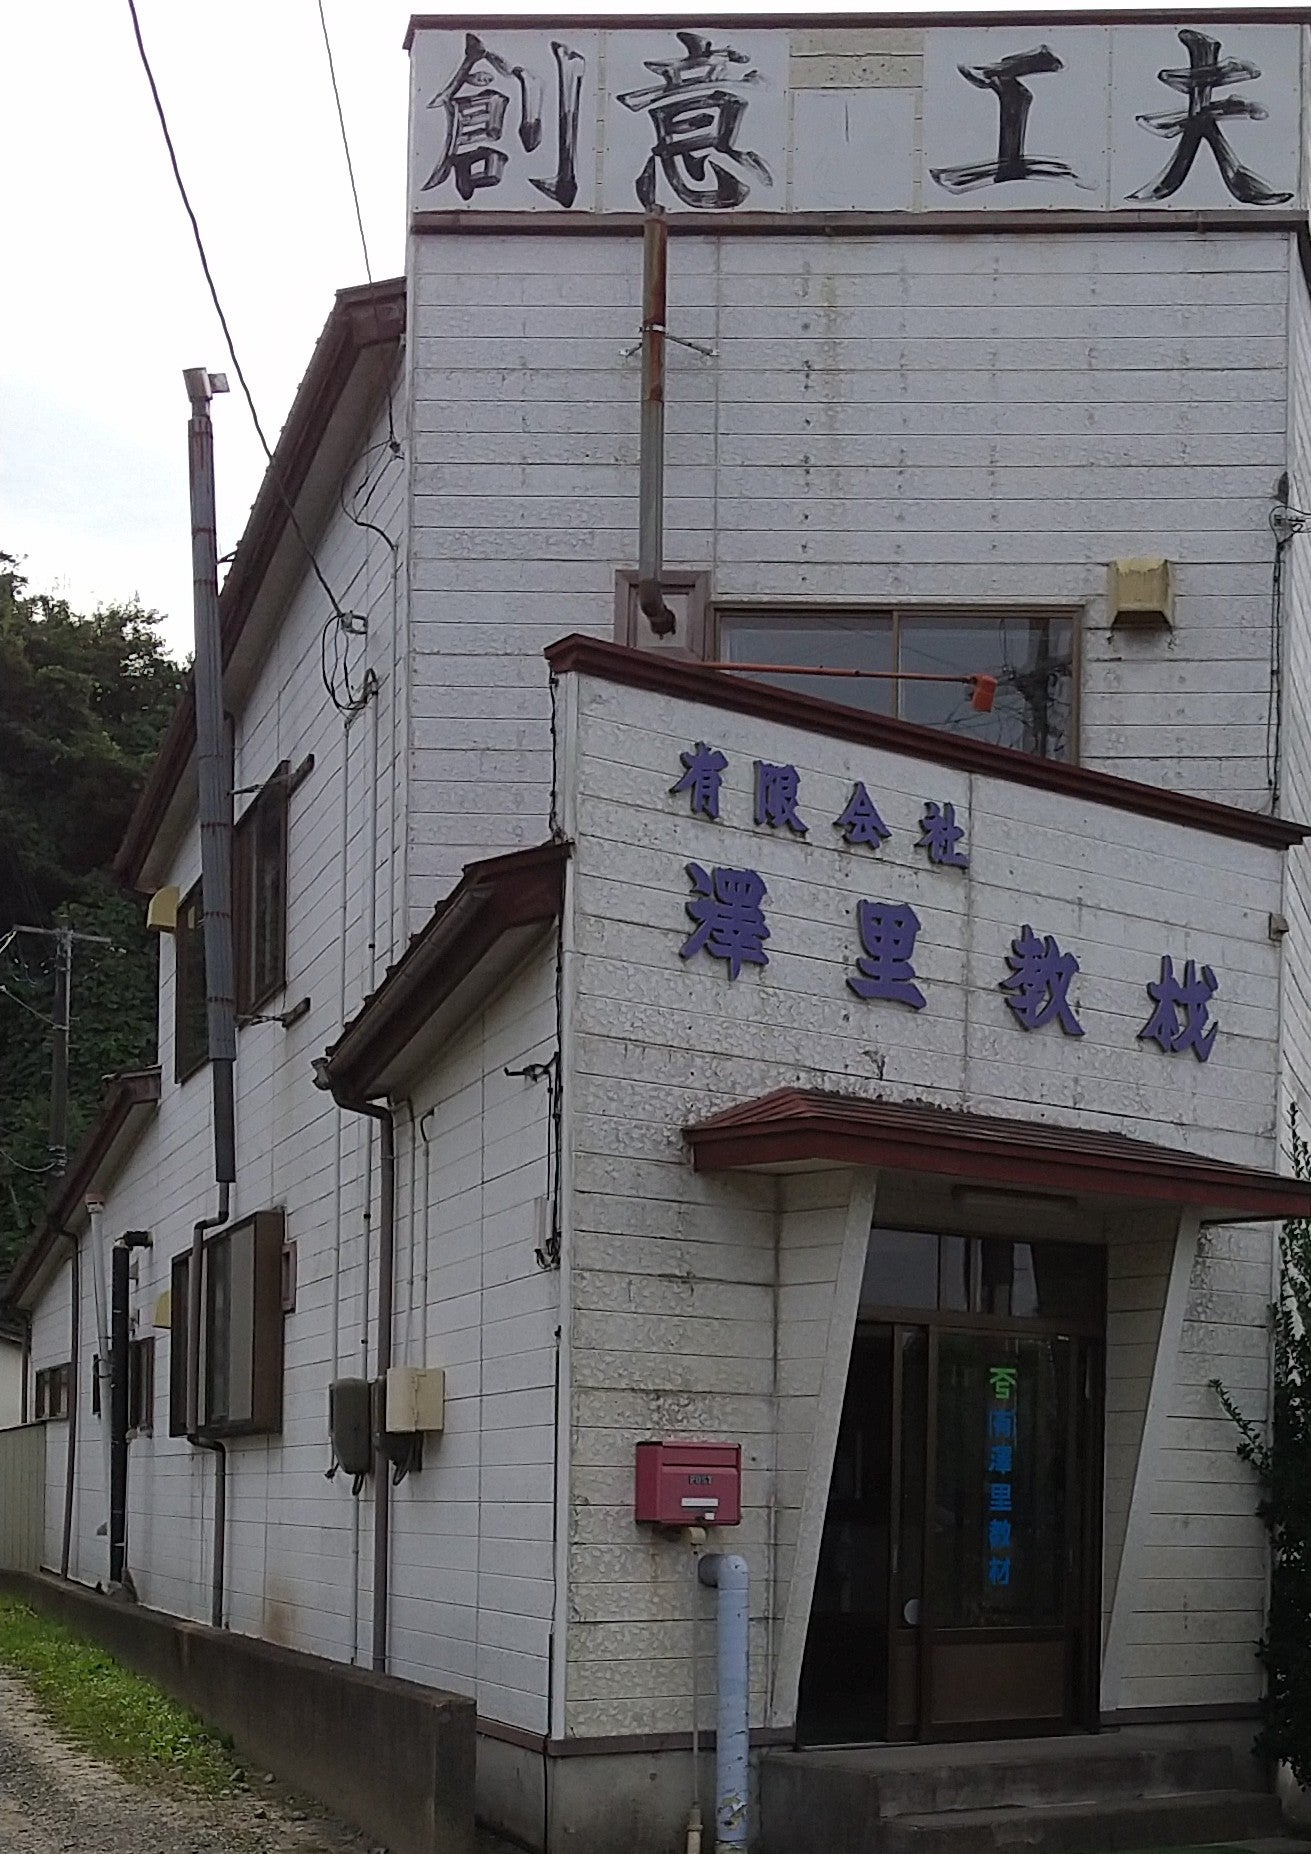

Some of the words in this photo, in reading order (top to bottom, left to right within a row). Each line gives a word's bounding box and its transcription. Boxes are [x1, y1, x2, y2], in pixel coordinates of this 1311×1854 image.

[422, 30, 1294, 209] 創意工夫
[670, 741, 970, 869] 有限会社
